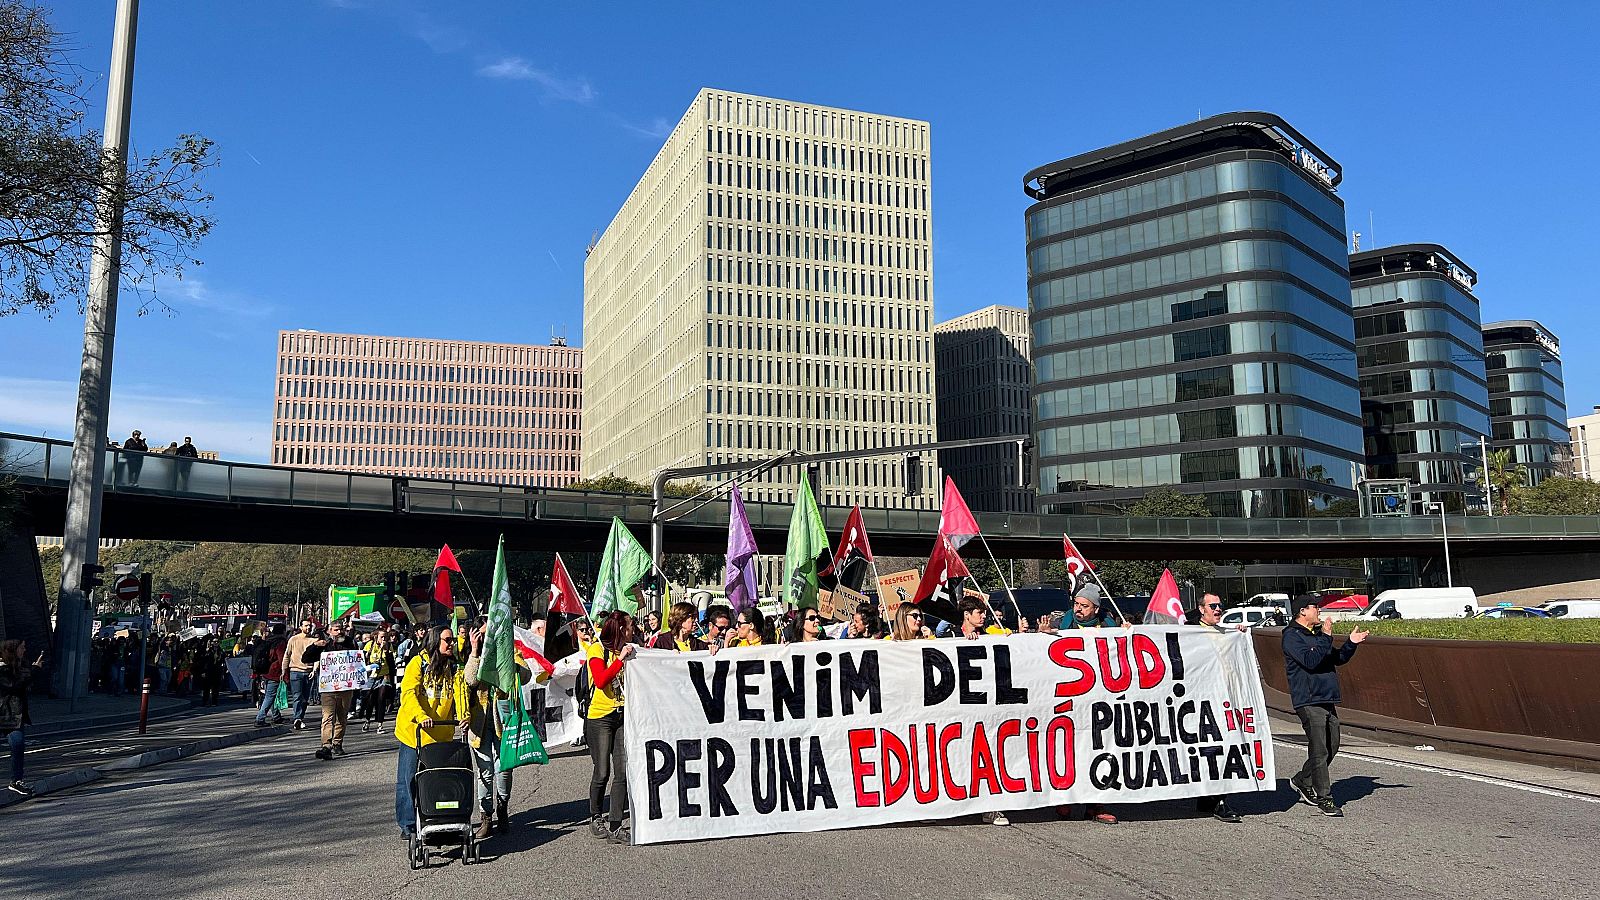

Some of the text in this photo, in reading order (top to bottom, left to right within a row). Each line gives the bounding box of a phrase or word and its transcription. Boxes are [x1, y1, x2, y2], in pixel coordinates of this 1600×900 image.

[884, 574, 915, 586] RESPECTE
[921, 644, 1029, 706] DEL
[1047, 632, 1186, 698] SUD!
[645, 737, 740, 820] PER
[750, 736, 839, 814] UNA
